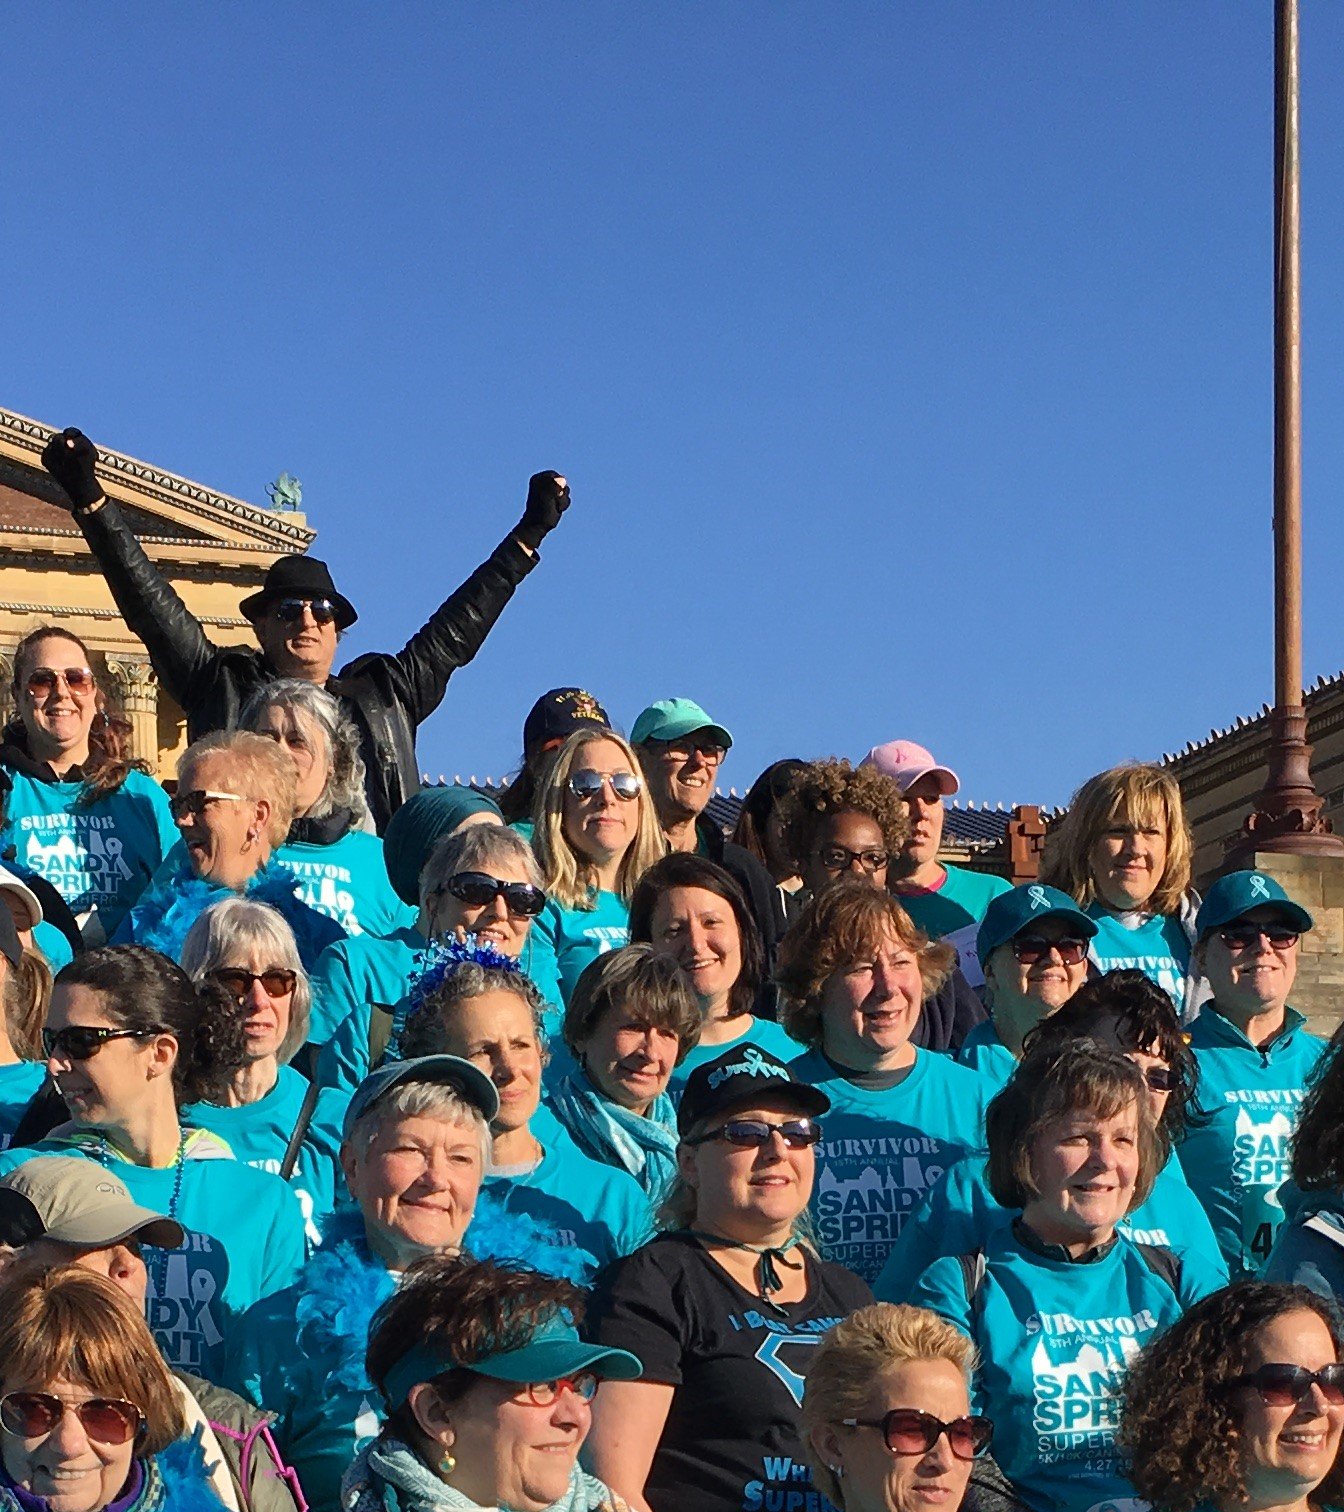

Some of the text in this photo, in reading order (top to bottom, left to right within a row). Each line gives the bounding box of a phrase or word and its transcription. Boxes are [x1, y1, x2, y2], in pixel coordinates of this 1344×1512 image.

[20, 813, 115, 831] SURVIVOR
[28, 853, 119, 873] SANDY
[278, 860, 351, 883] VIVOR
[46, 873, 121, 892] PRINT
[1224, 1089, 1308, 1103] SURVIV
[814, 1137, 940, 1158] SURVIVOR
[819, 1213, 909, 1244] SPRI
[1026, 1309, 1158, 1336] SURVIVOR
[1035, 1369, 1121, 1400] SAN
[1035, 1398, 1119, 1432] SPR
[1037, 1432, 1116, 1453] SUPER
